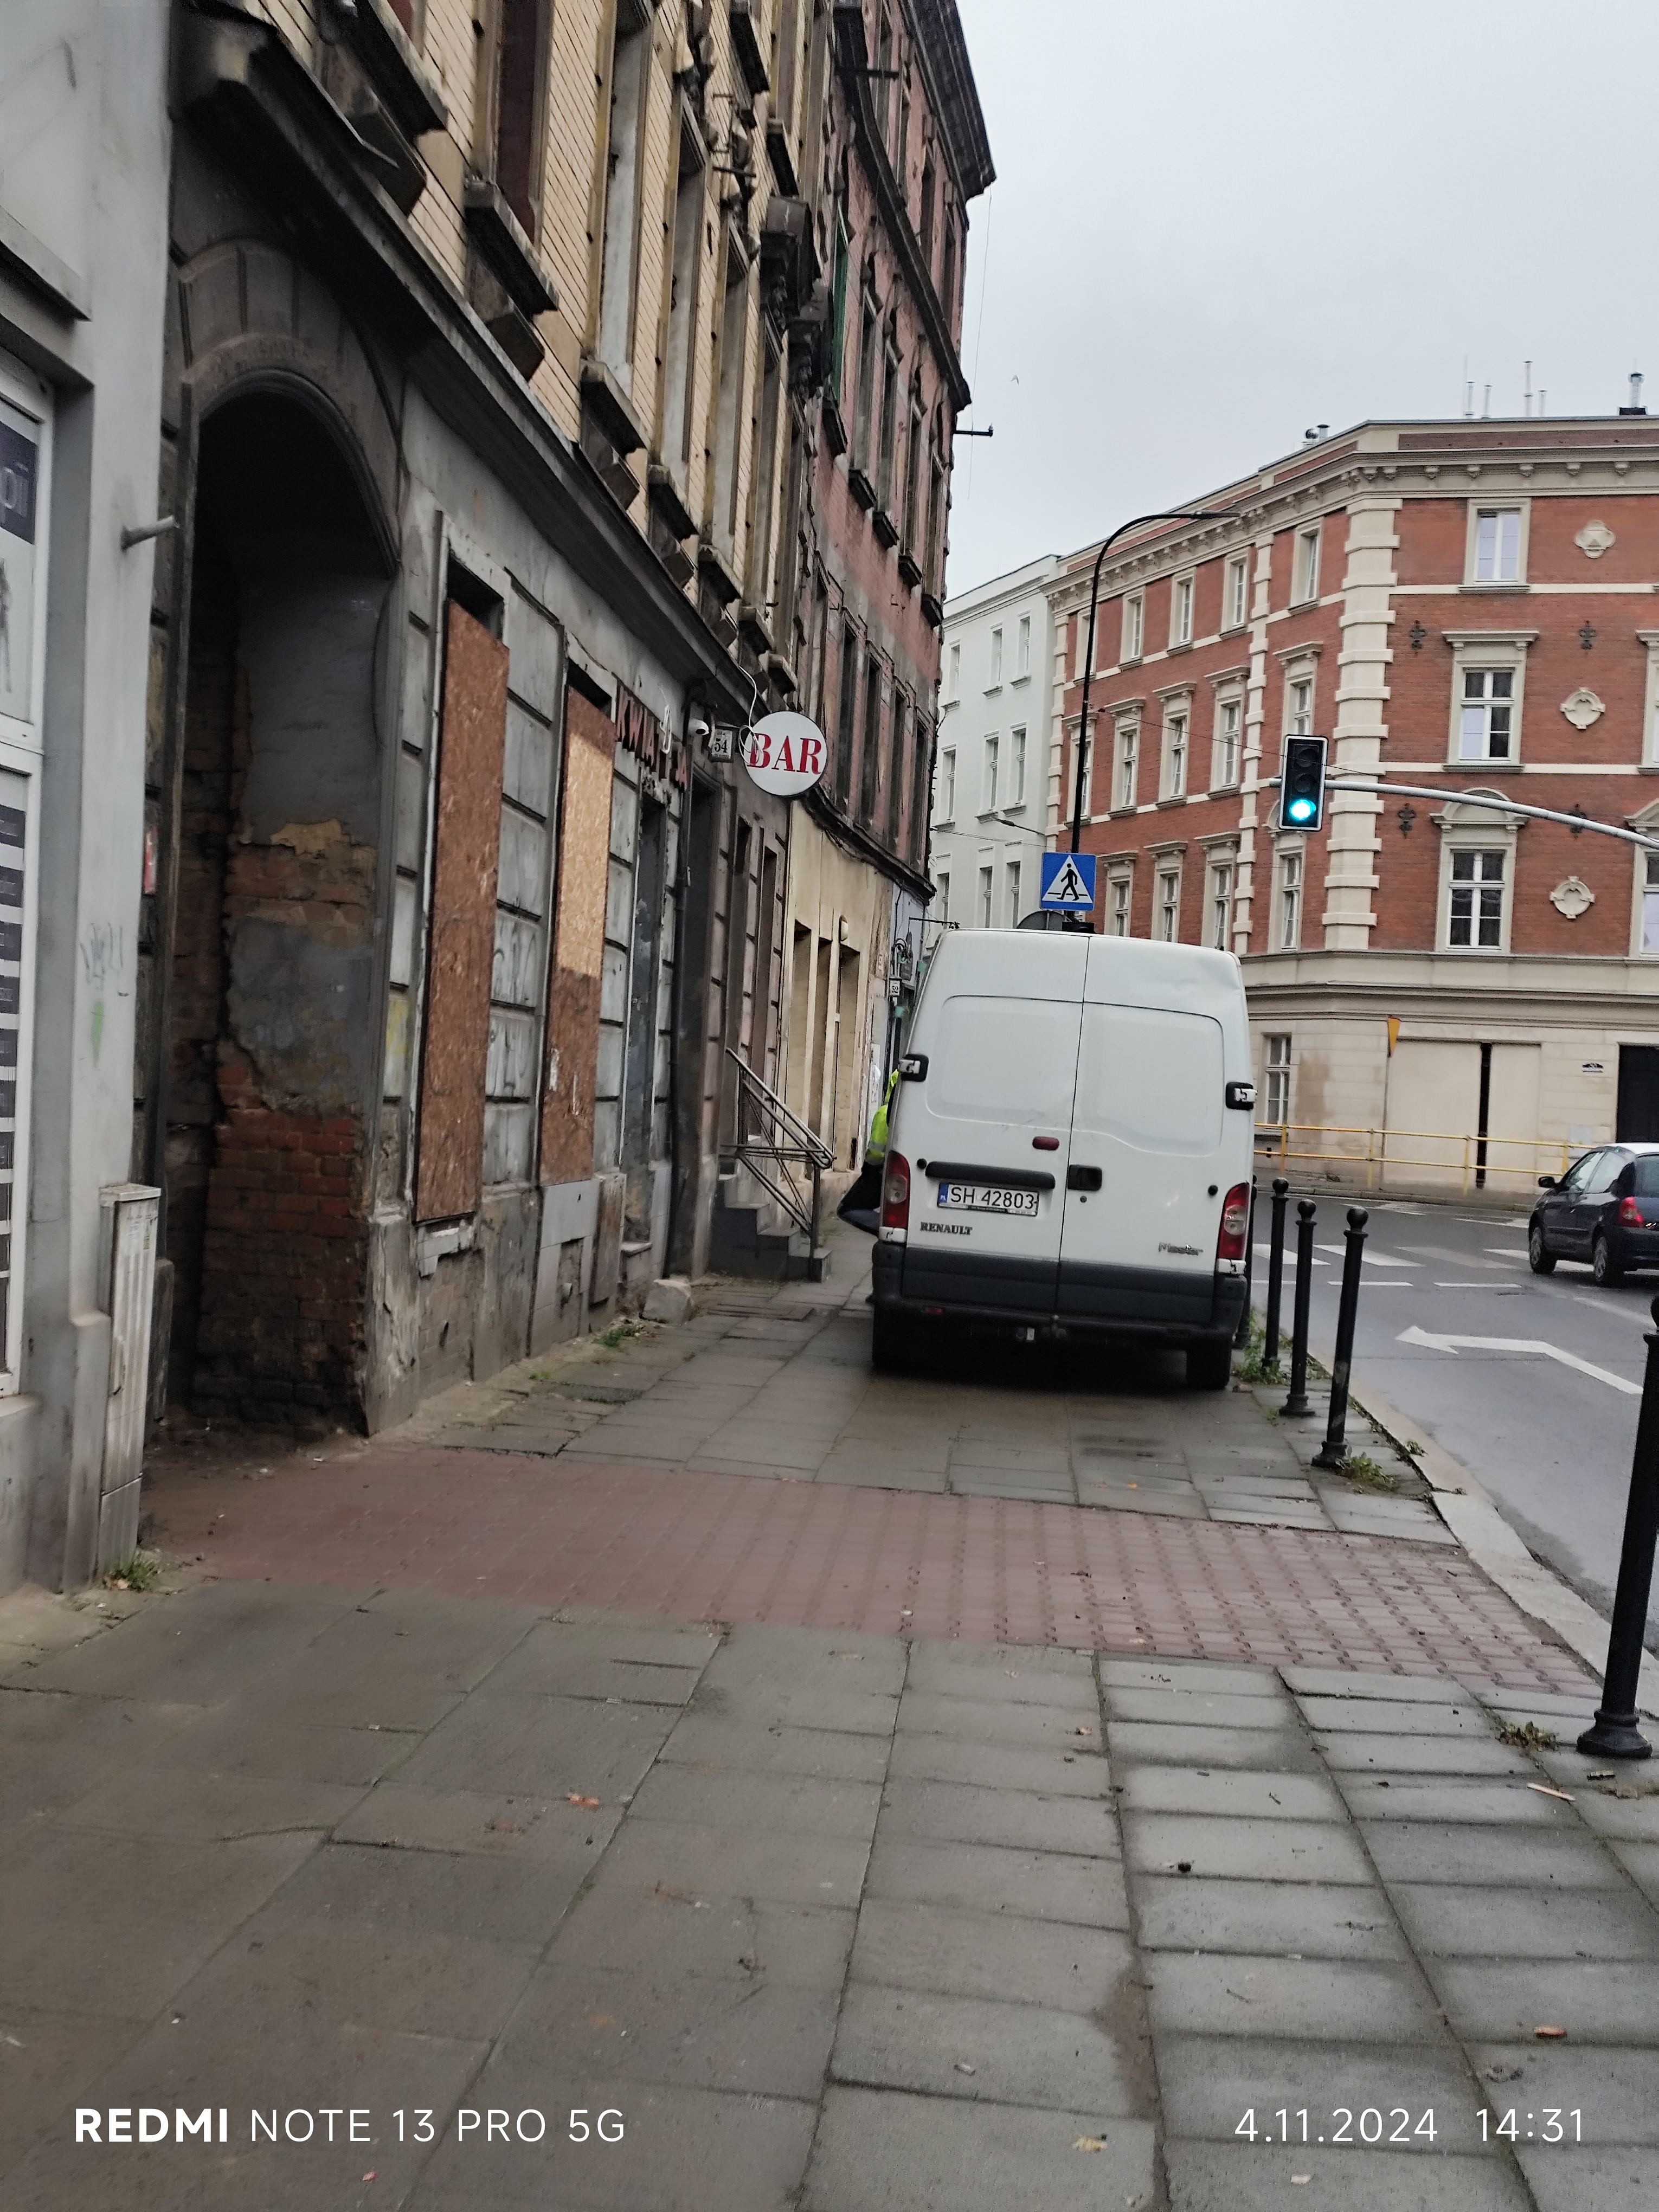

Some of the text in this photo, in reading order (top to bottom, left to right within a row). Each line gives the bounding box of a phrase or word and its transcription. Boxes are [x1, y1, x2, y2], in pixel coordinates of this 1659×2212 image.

[715, 738, 728, 753] 54
[747, 732, 821, 775] BAR
[950, 1187, 1034, 1209] SH 42803
[919, 1221, 973, 1236] RENAULT
